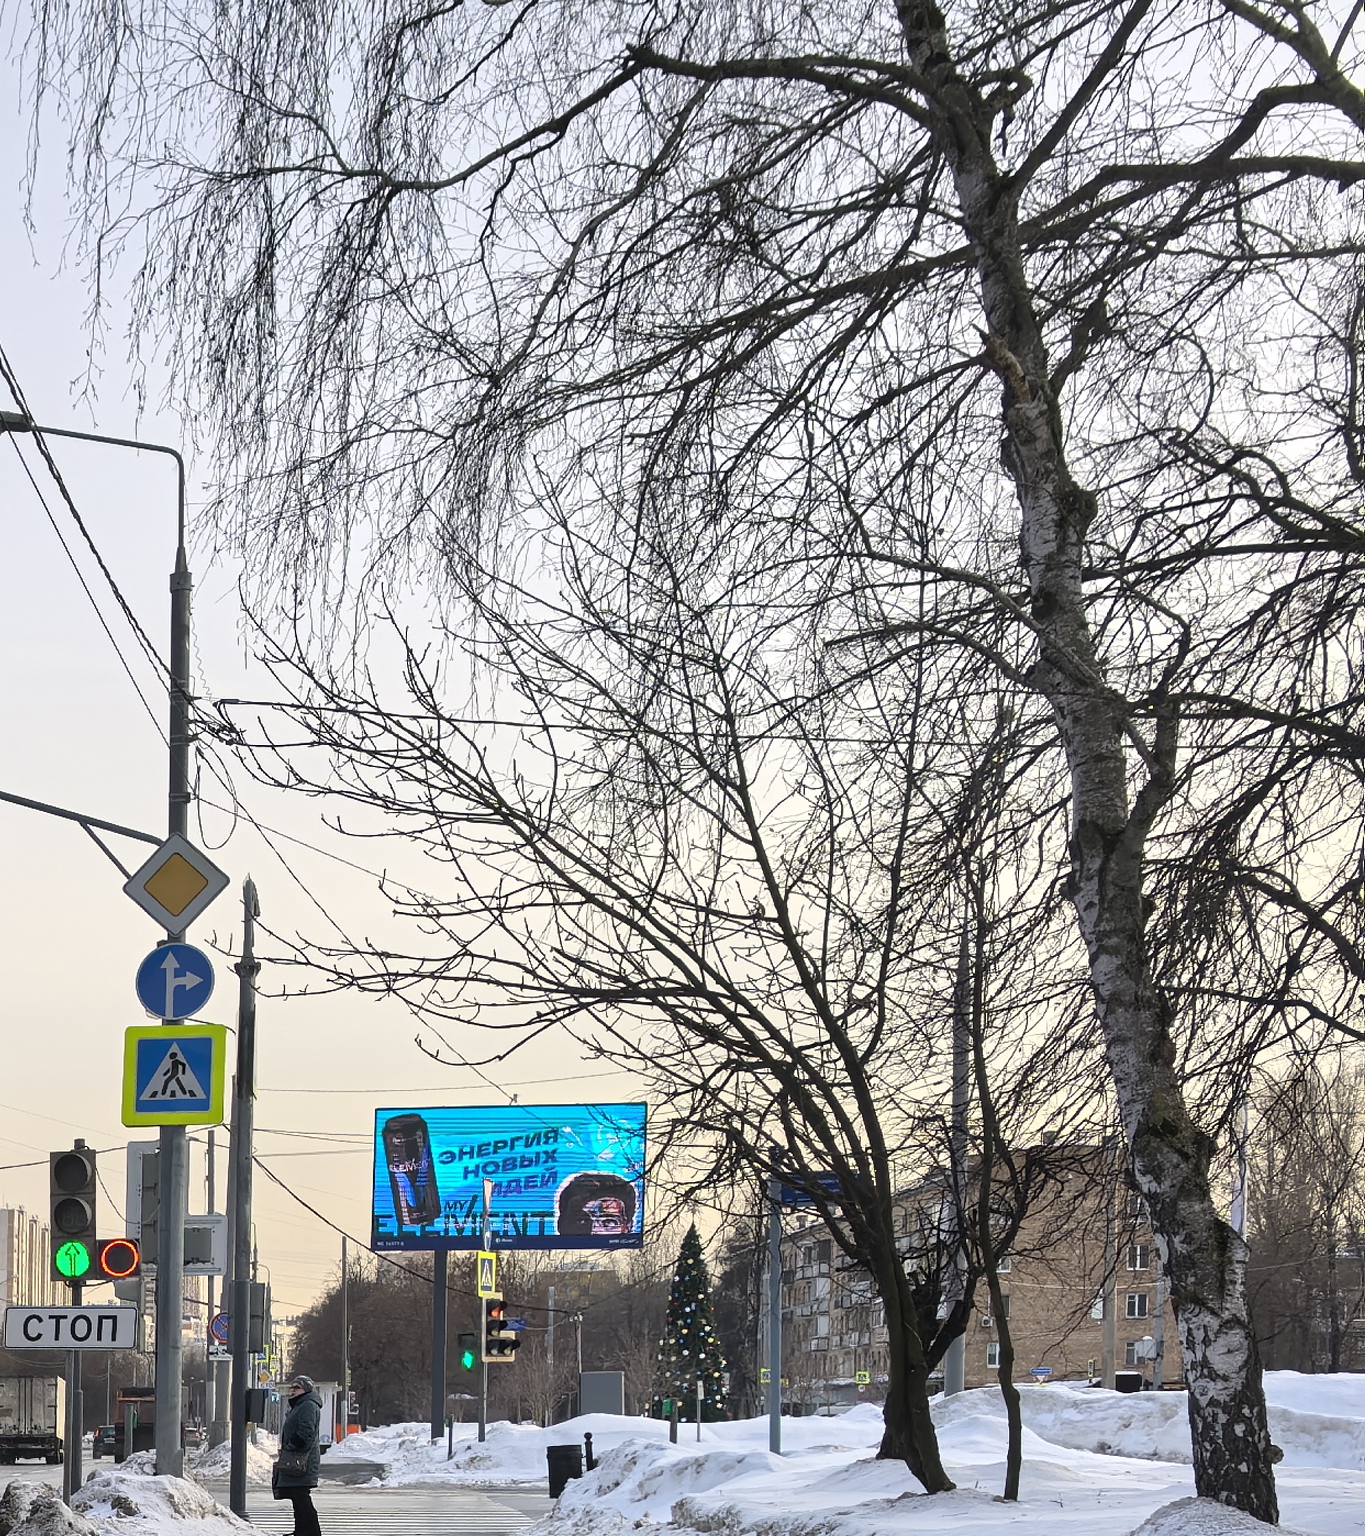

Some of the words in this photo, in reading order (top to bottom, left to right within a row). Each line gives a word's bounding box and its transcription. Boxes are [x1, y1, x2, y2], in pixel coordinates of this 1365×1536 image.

[438, 1128, 559, 1165] ЭНЕРГИЯ
[463, 1148, 558, 1180] НОВЫХ
[492, 1165, 558, 1198] ИДЕЙ
[444, 1200, 468, 1212] MY
[374, 1212, 555, 1237] EMENT
[23, 1314, 118, 1342] СТОП
